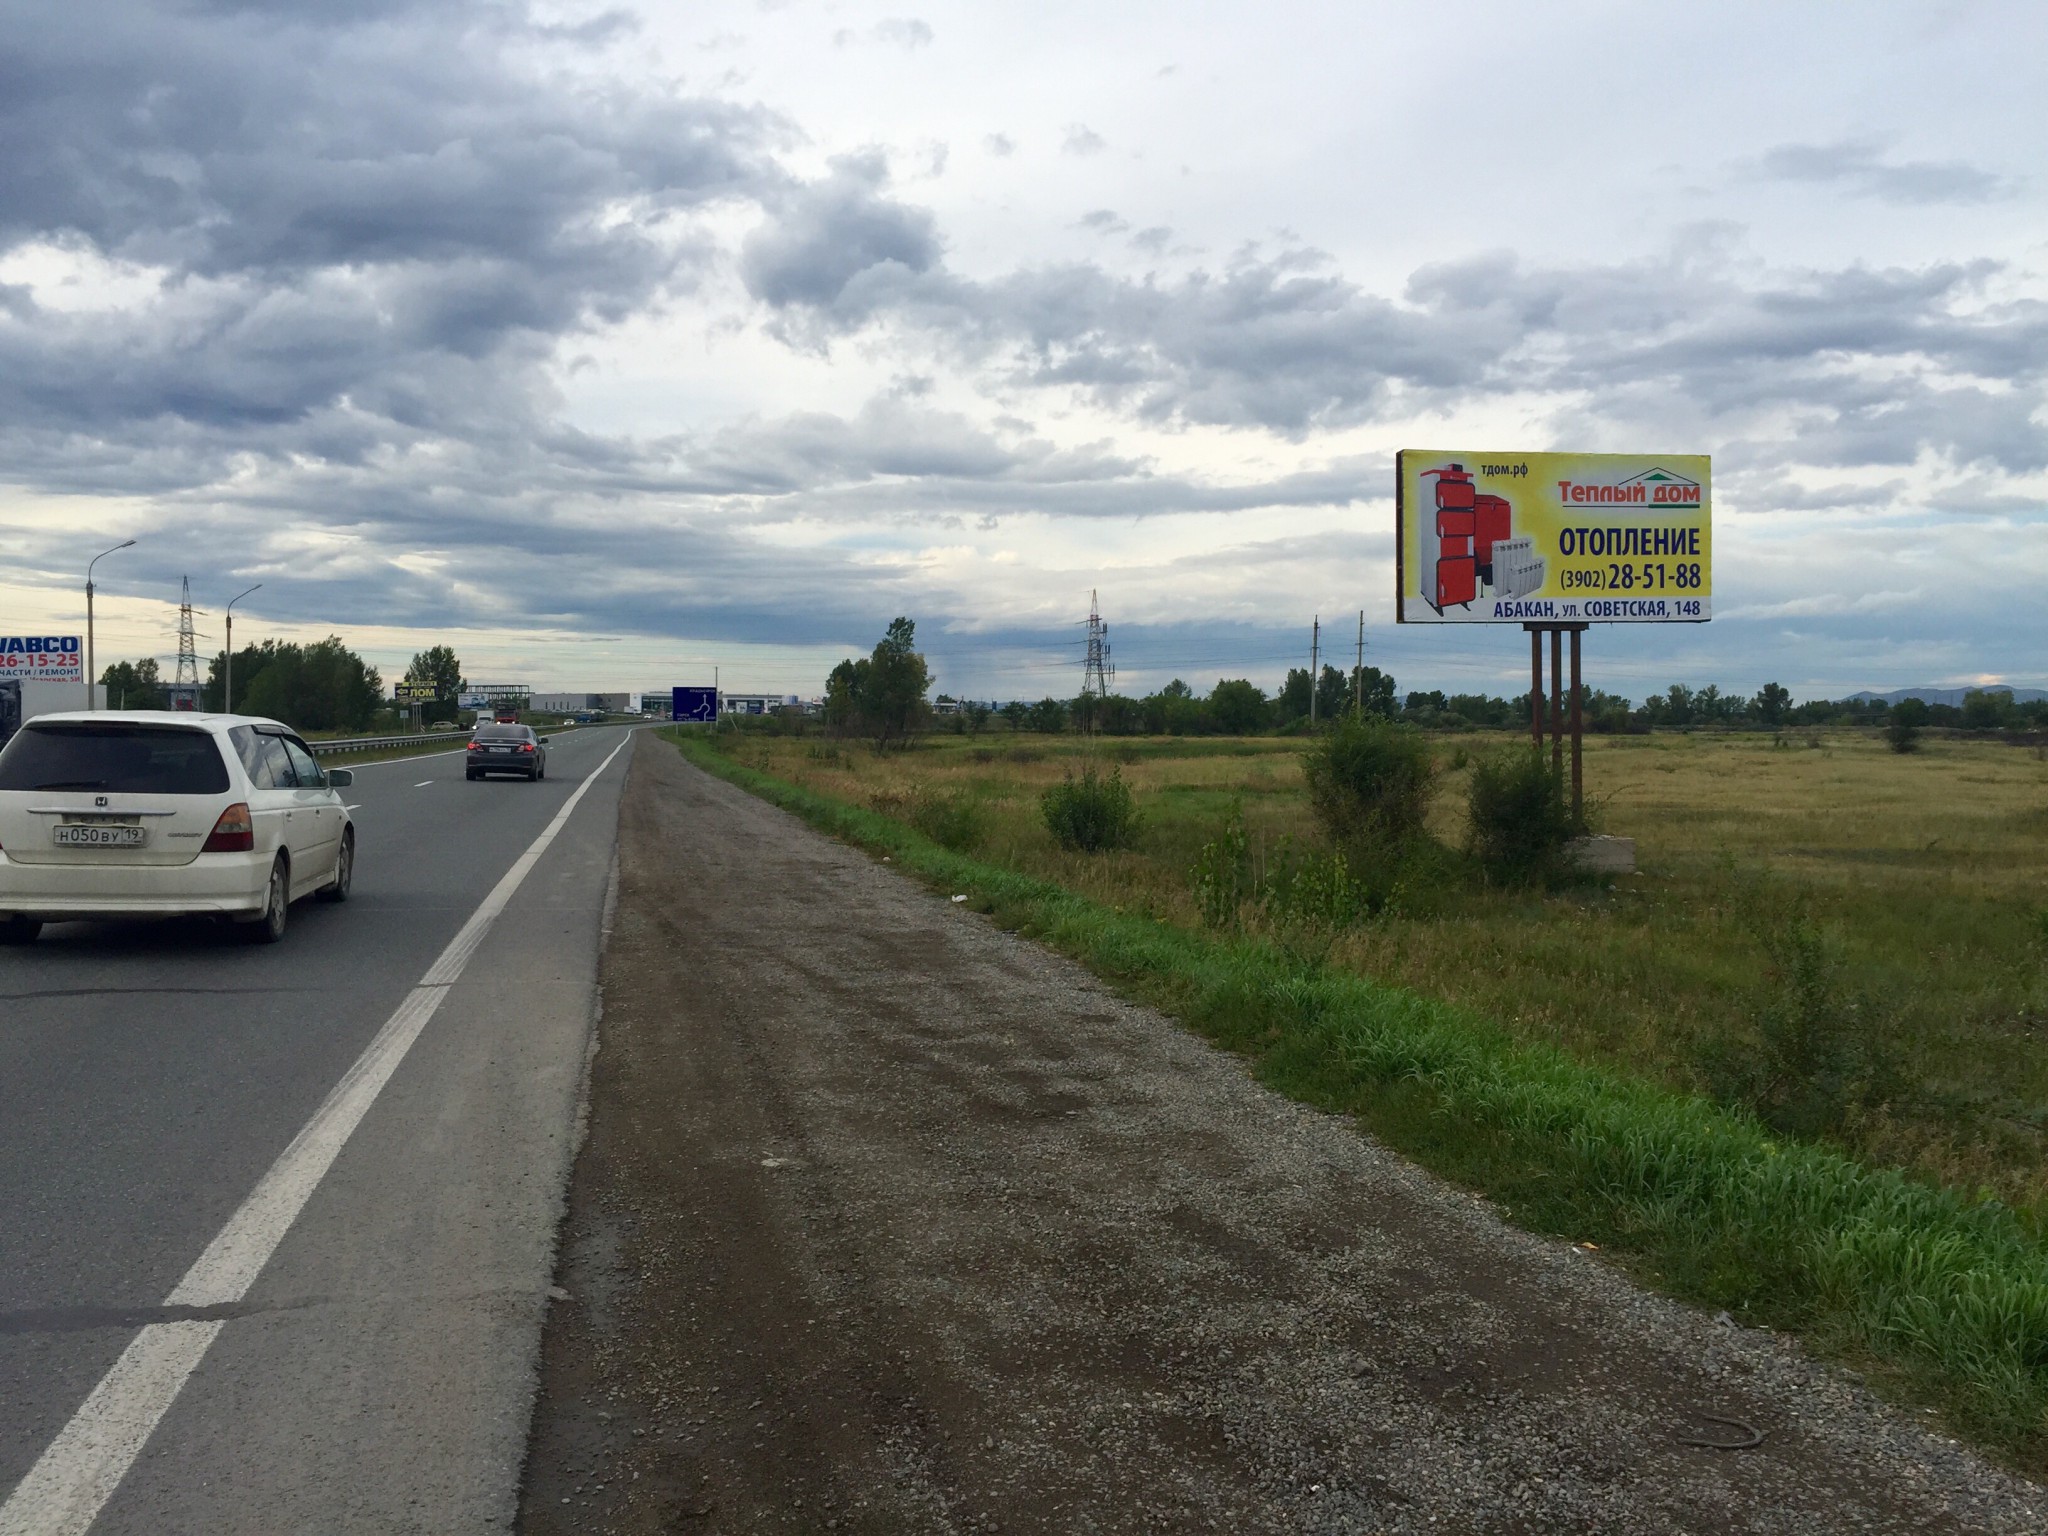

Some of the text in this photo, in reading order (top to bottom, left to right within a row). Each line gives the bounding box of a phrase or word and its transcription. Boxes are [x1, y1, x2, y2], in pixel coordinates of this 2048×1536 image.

[1481, 462, 1528, 478] тдом.рф
[1558, 481, 1700, 503] Теплый дом
[1559, 528, 1700, 556] ОТОПЛЕНИЕ
[1560, 563, 1701, 590] (3902) 28-51-88
[1494, 601, 1701, 619] АБАКАН, ул. СОВЕТСКАЯ, 148
[409, 688, 435, 697] ЛОМ
